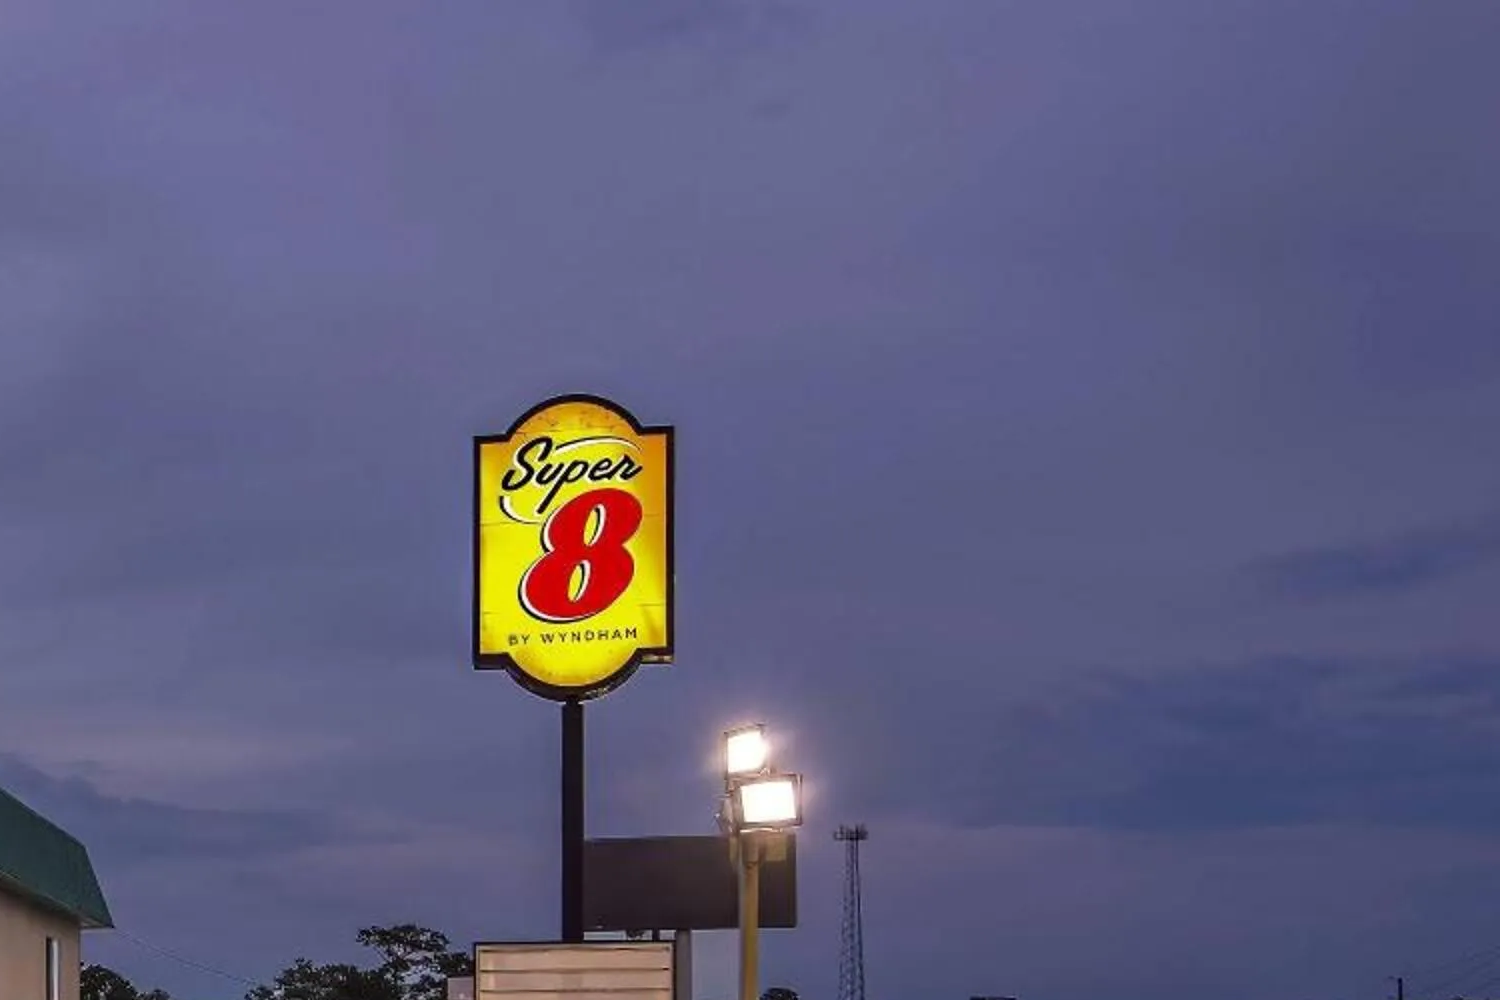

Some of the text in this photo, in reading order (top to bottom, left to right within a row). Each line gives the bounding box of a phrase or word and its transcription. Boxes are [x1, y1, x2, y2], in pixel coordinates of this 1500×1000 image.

[501, 436, 643, 515] Super
[518, 488, 643, 624] 8
[508, 627, 637, 646] BY WYNDHAM
